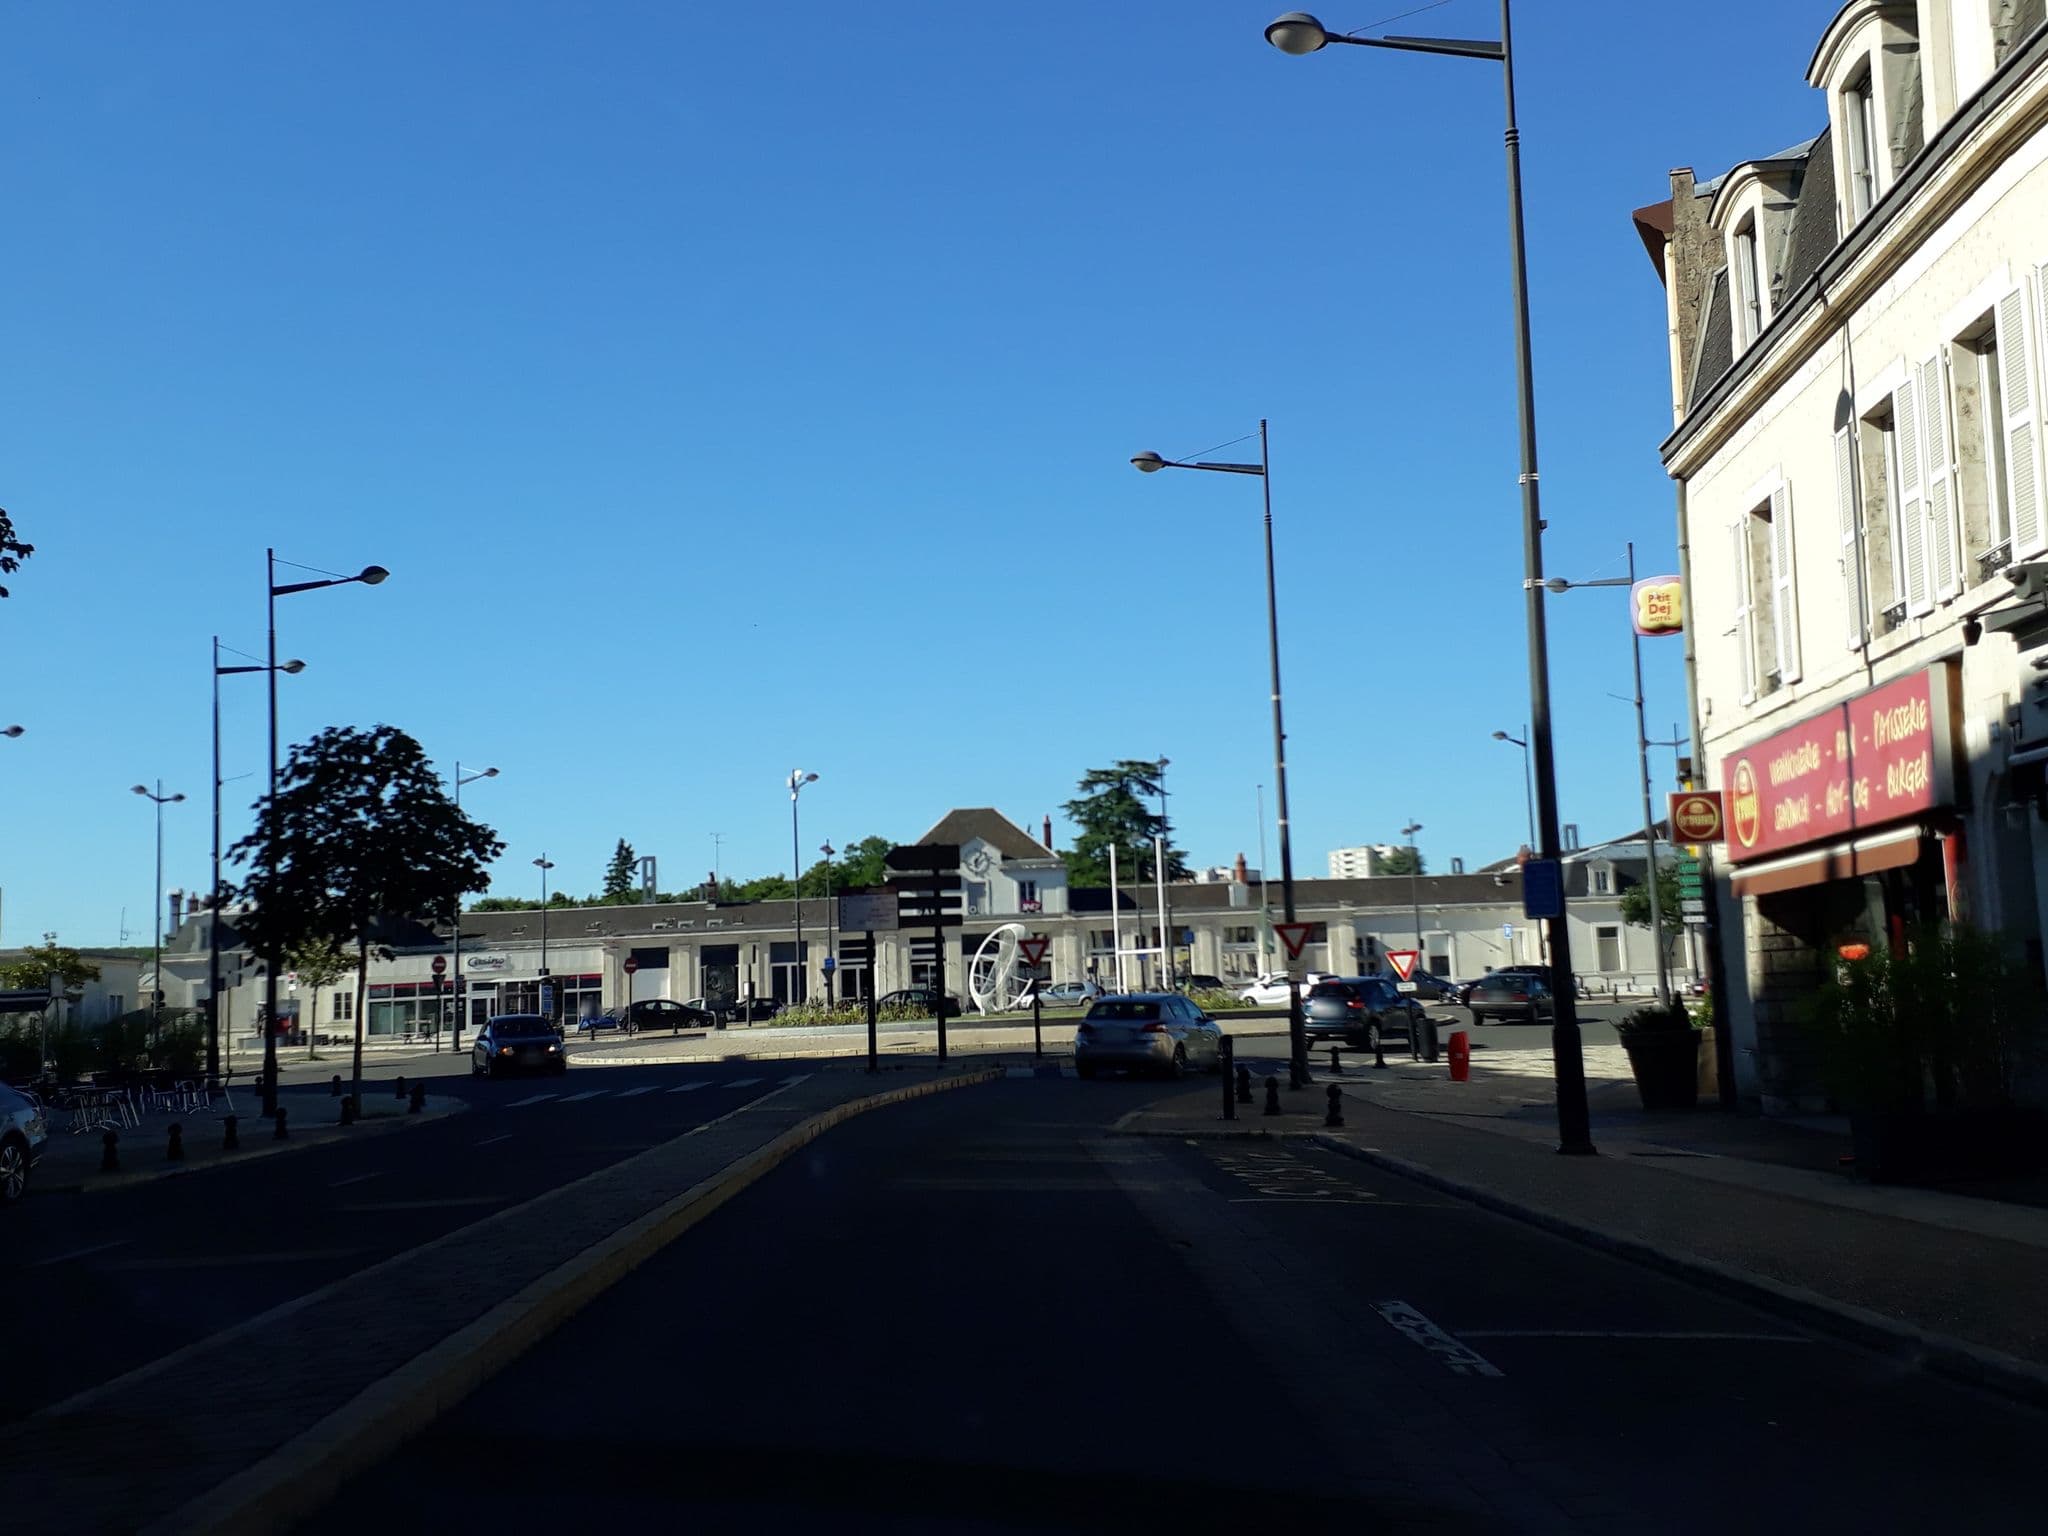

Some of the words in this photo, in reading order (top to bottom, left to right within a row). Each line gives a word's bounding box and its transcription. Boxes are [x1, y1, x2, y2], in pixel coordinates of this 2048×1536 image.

[1873, 696, 1926, 750] PATISSERIE
[1887, 750, 1928, 799] BURGER
[468, 955, 504, 968] Casino
